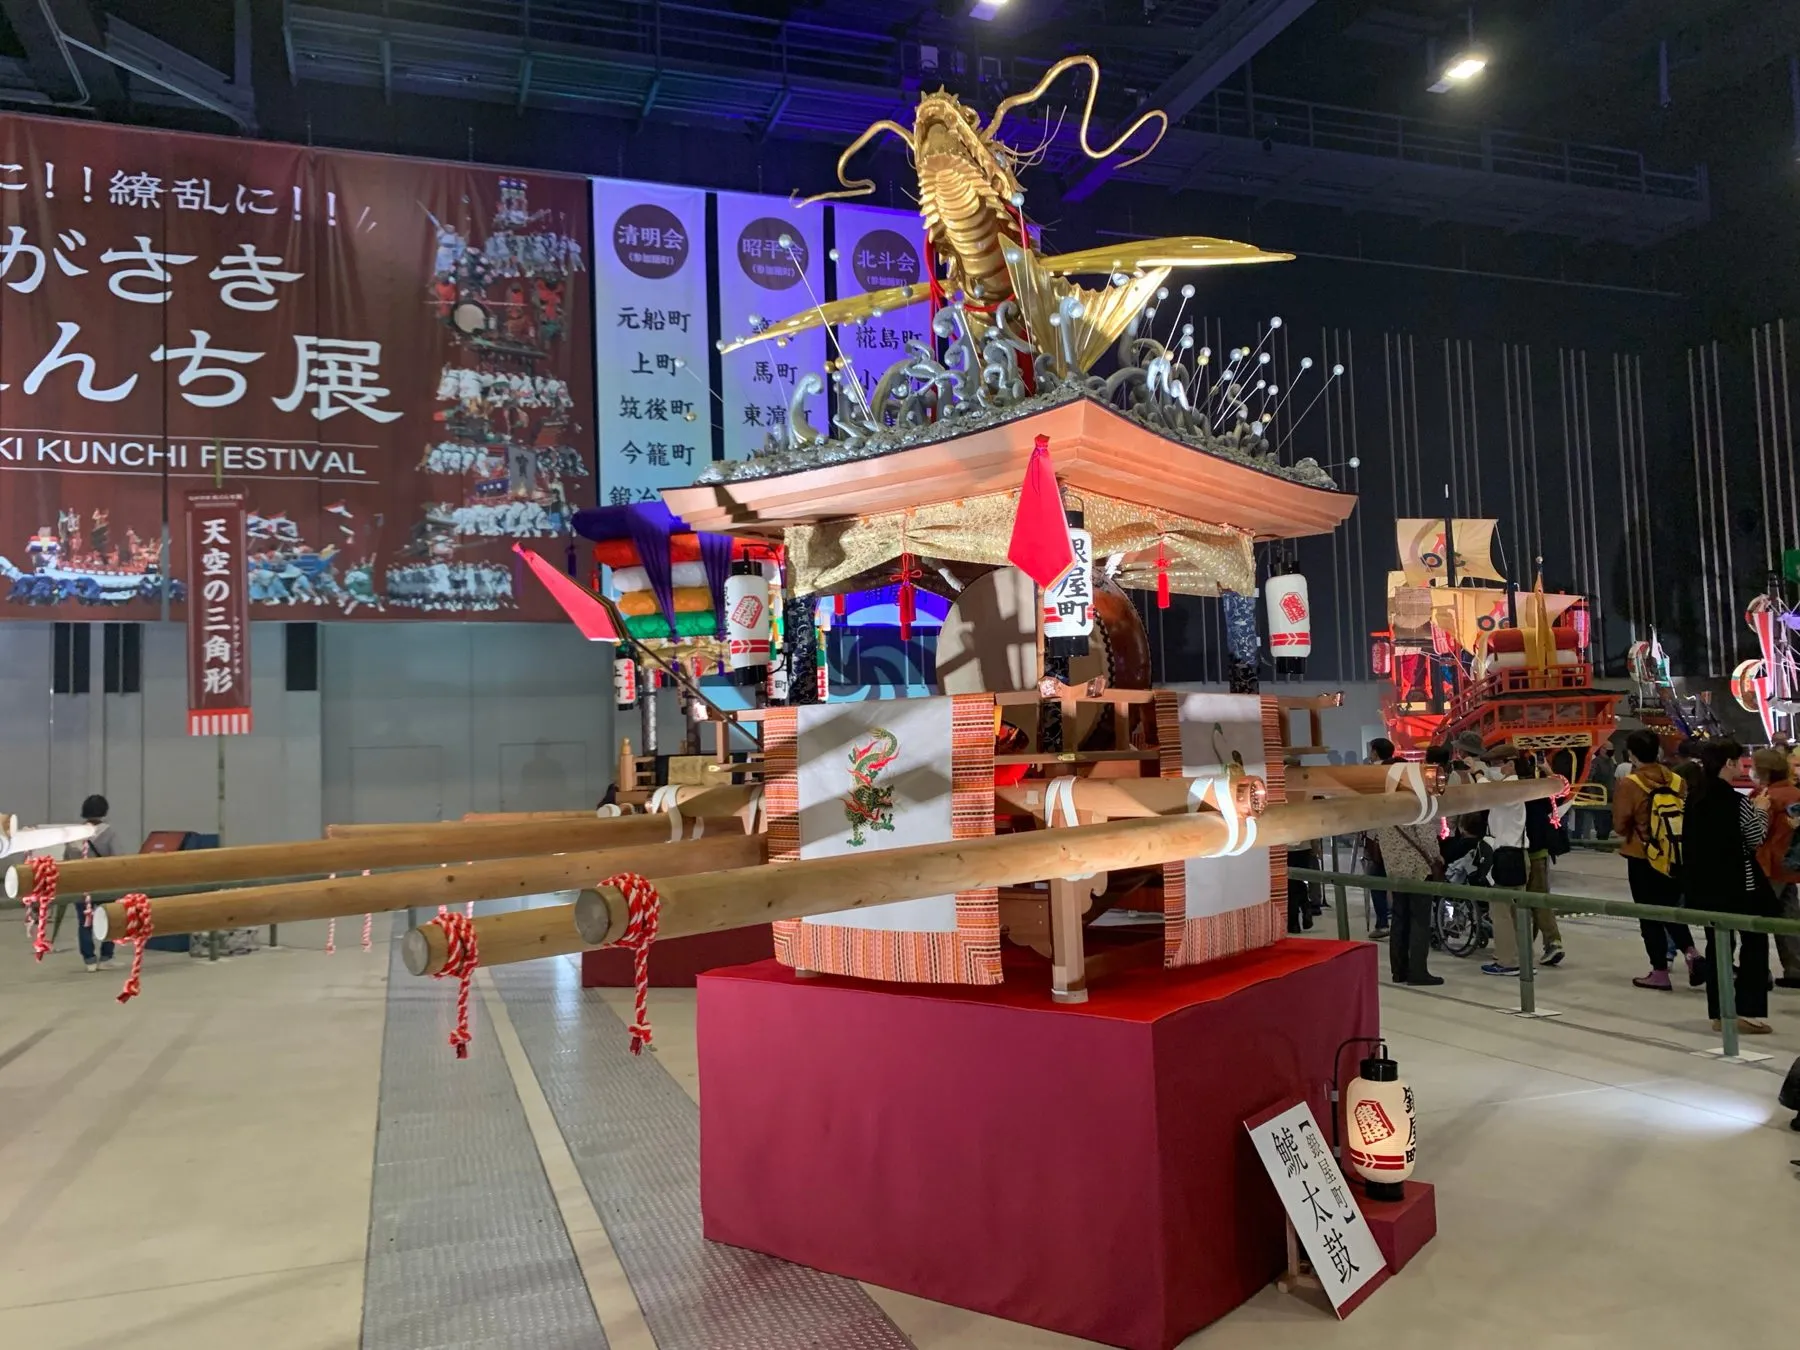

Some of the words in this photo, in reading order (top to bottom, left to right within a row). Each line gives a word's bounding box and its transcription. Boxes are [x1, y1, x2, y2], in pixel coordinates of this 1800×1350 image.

[617, 223, 684, 250] 清明会
[857, 249, 916, 274] 北斗会
[617, 307, 691, 333] 元船町
[0, 321, 404, 424] んち展
[631, 352, 683, 377] 上町
[753, 361, 799, 385] 馬町
[619, 394, 695, 422] 筑後町
[37, 438, 187, 467] KUNCHI
[201, 446, 366, 475] FESTIVAL
[620, 440, 695, 466] 今籠町
[201, 518, 232, 694] 天空の三角形
